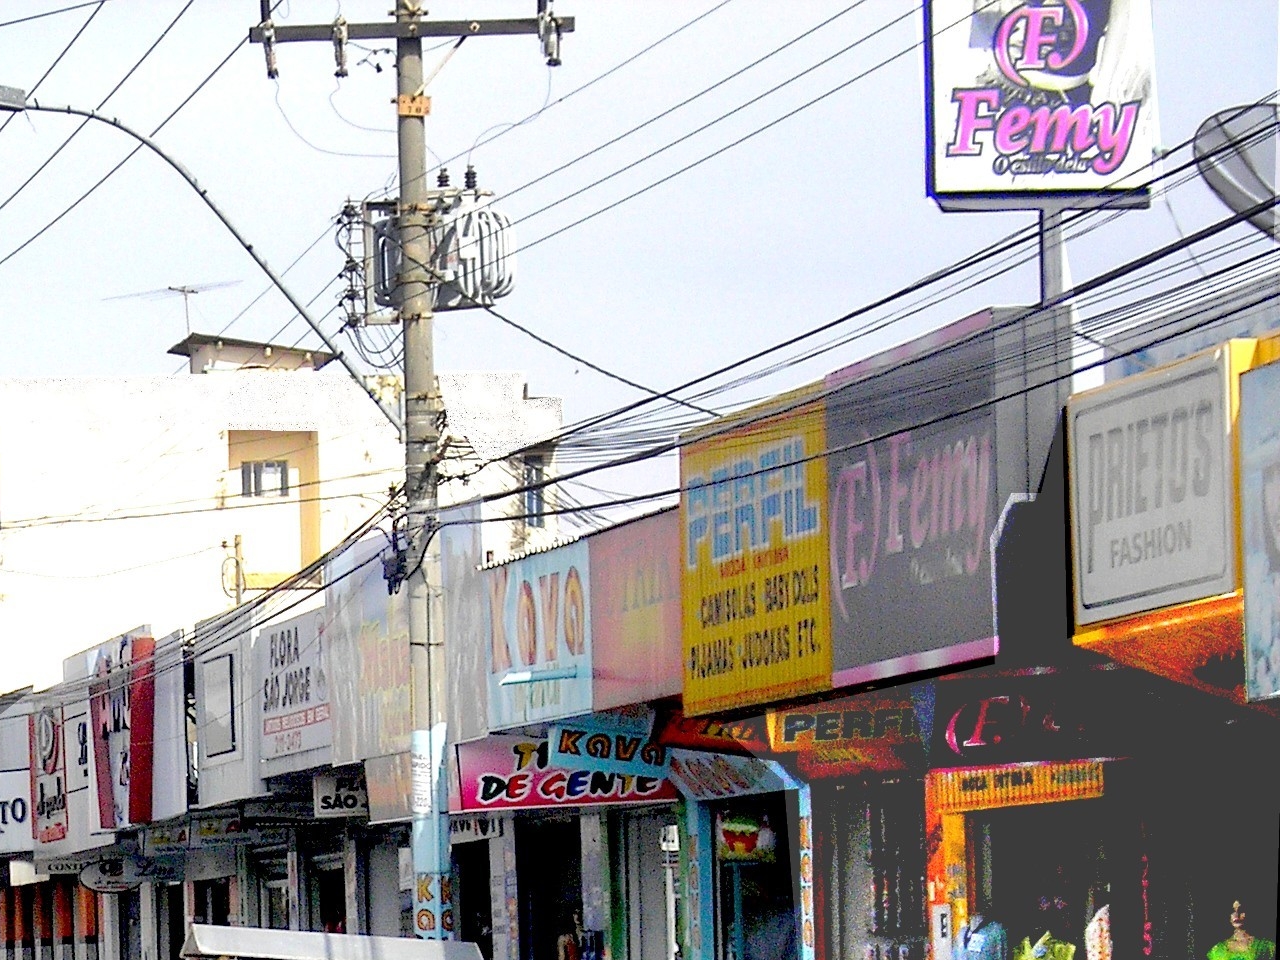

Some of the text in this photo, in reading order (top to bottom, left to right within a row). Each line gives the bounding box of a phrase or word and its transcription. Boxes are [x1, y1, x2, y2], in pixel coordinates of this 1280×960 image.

[946, 88, 1142, 175] Femy
[687, 436, 820, 571] PERFIL
[885, 430, 990, 576] Femy
[1110, 518, 1192, 568] FASHION
[269, 626, 300, 669] FLORA
[262, 665, 311, 714] SÃO JORGE
[320, 793, 358, 811] SÃO
[481, 772, 529, 801] DE
[541, 768, 659, 799] GENTE
